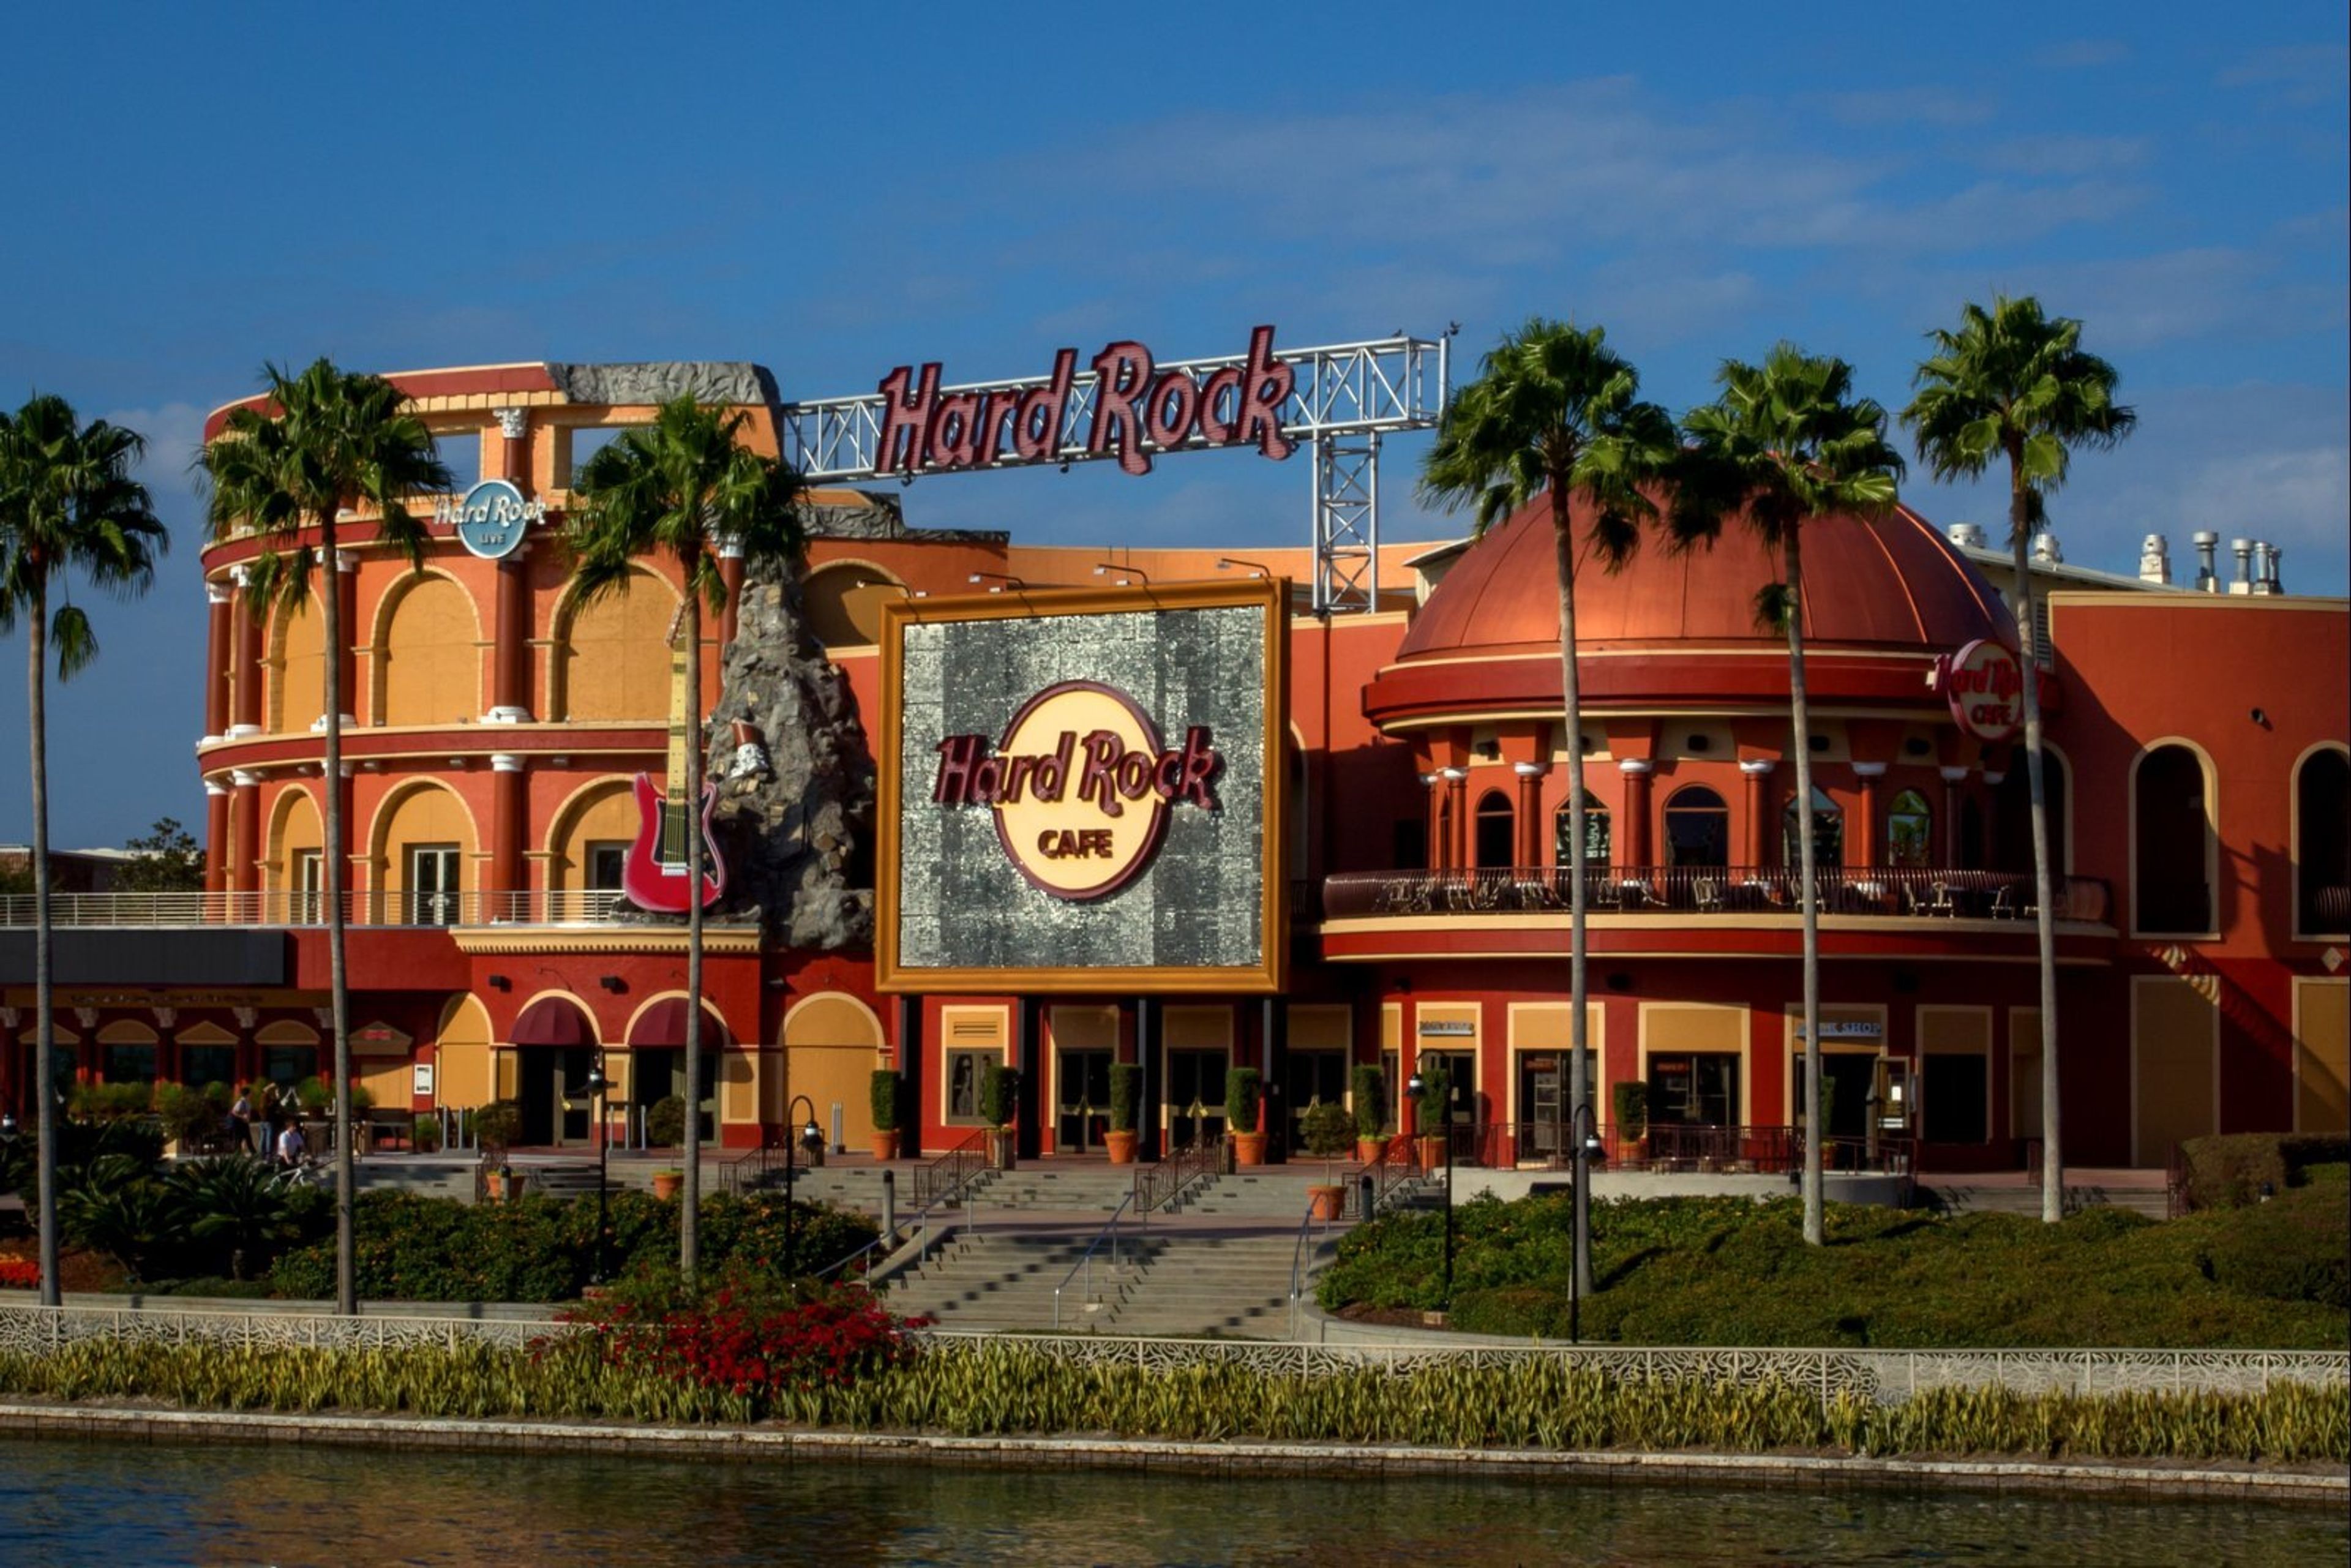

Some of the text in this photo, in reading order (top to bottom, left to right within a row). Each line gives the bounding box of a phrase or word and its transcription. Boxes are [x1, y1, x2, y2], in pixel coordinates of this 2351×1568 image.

[875, 324, 1295, 475] Hard Rock
[434, 495, 546, 527] Hard Rock
[479, 534, 506, 546] LIVE
[1970, 704, 2011, 725] CAFE
[932, 726, 1224, 818] Hard Rock
[1037, 828, 1114, 860] CAFE
[1841, 1022, 1881, 1035] SHOP
